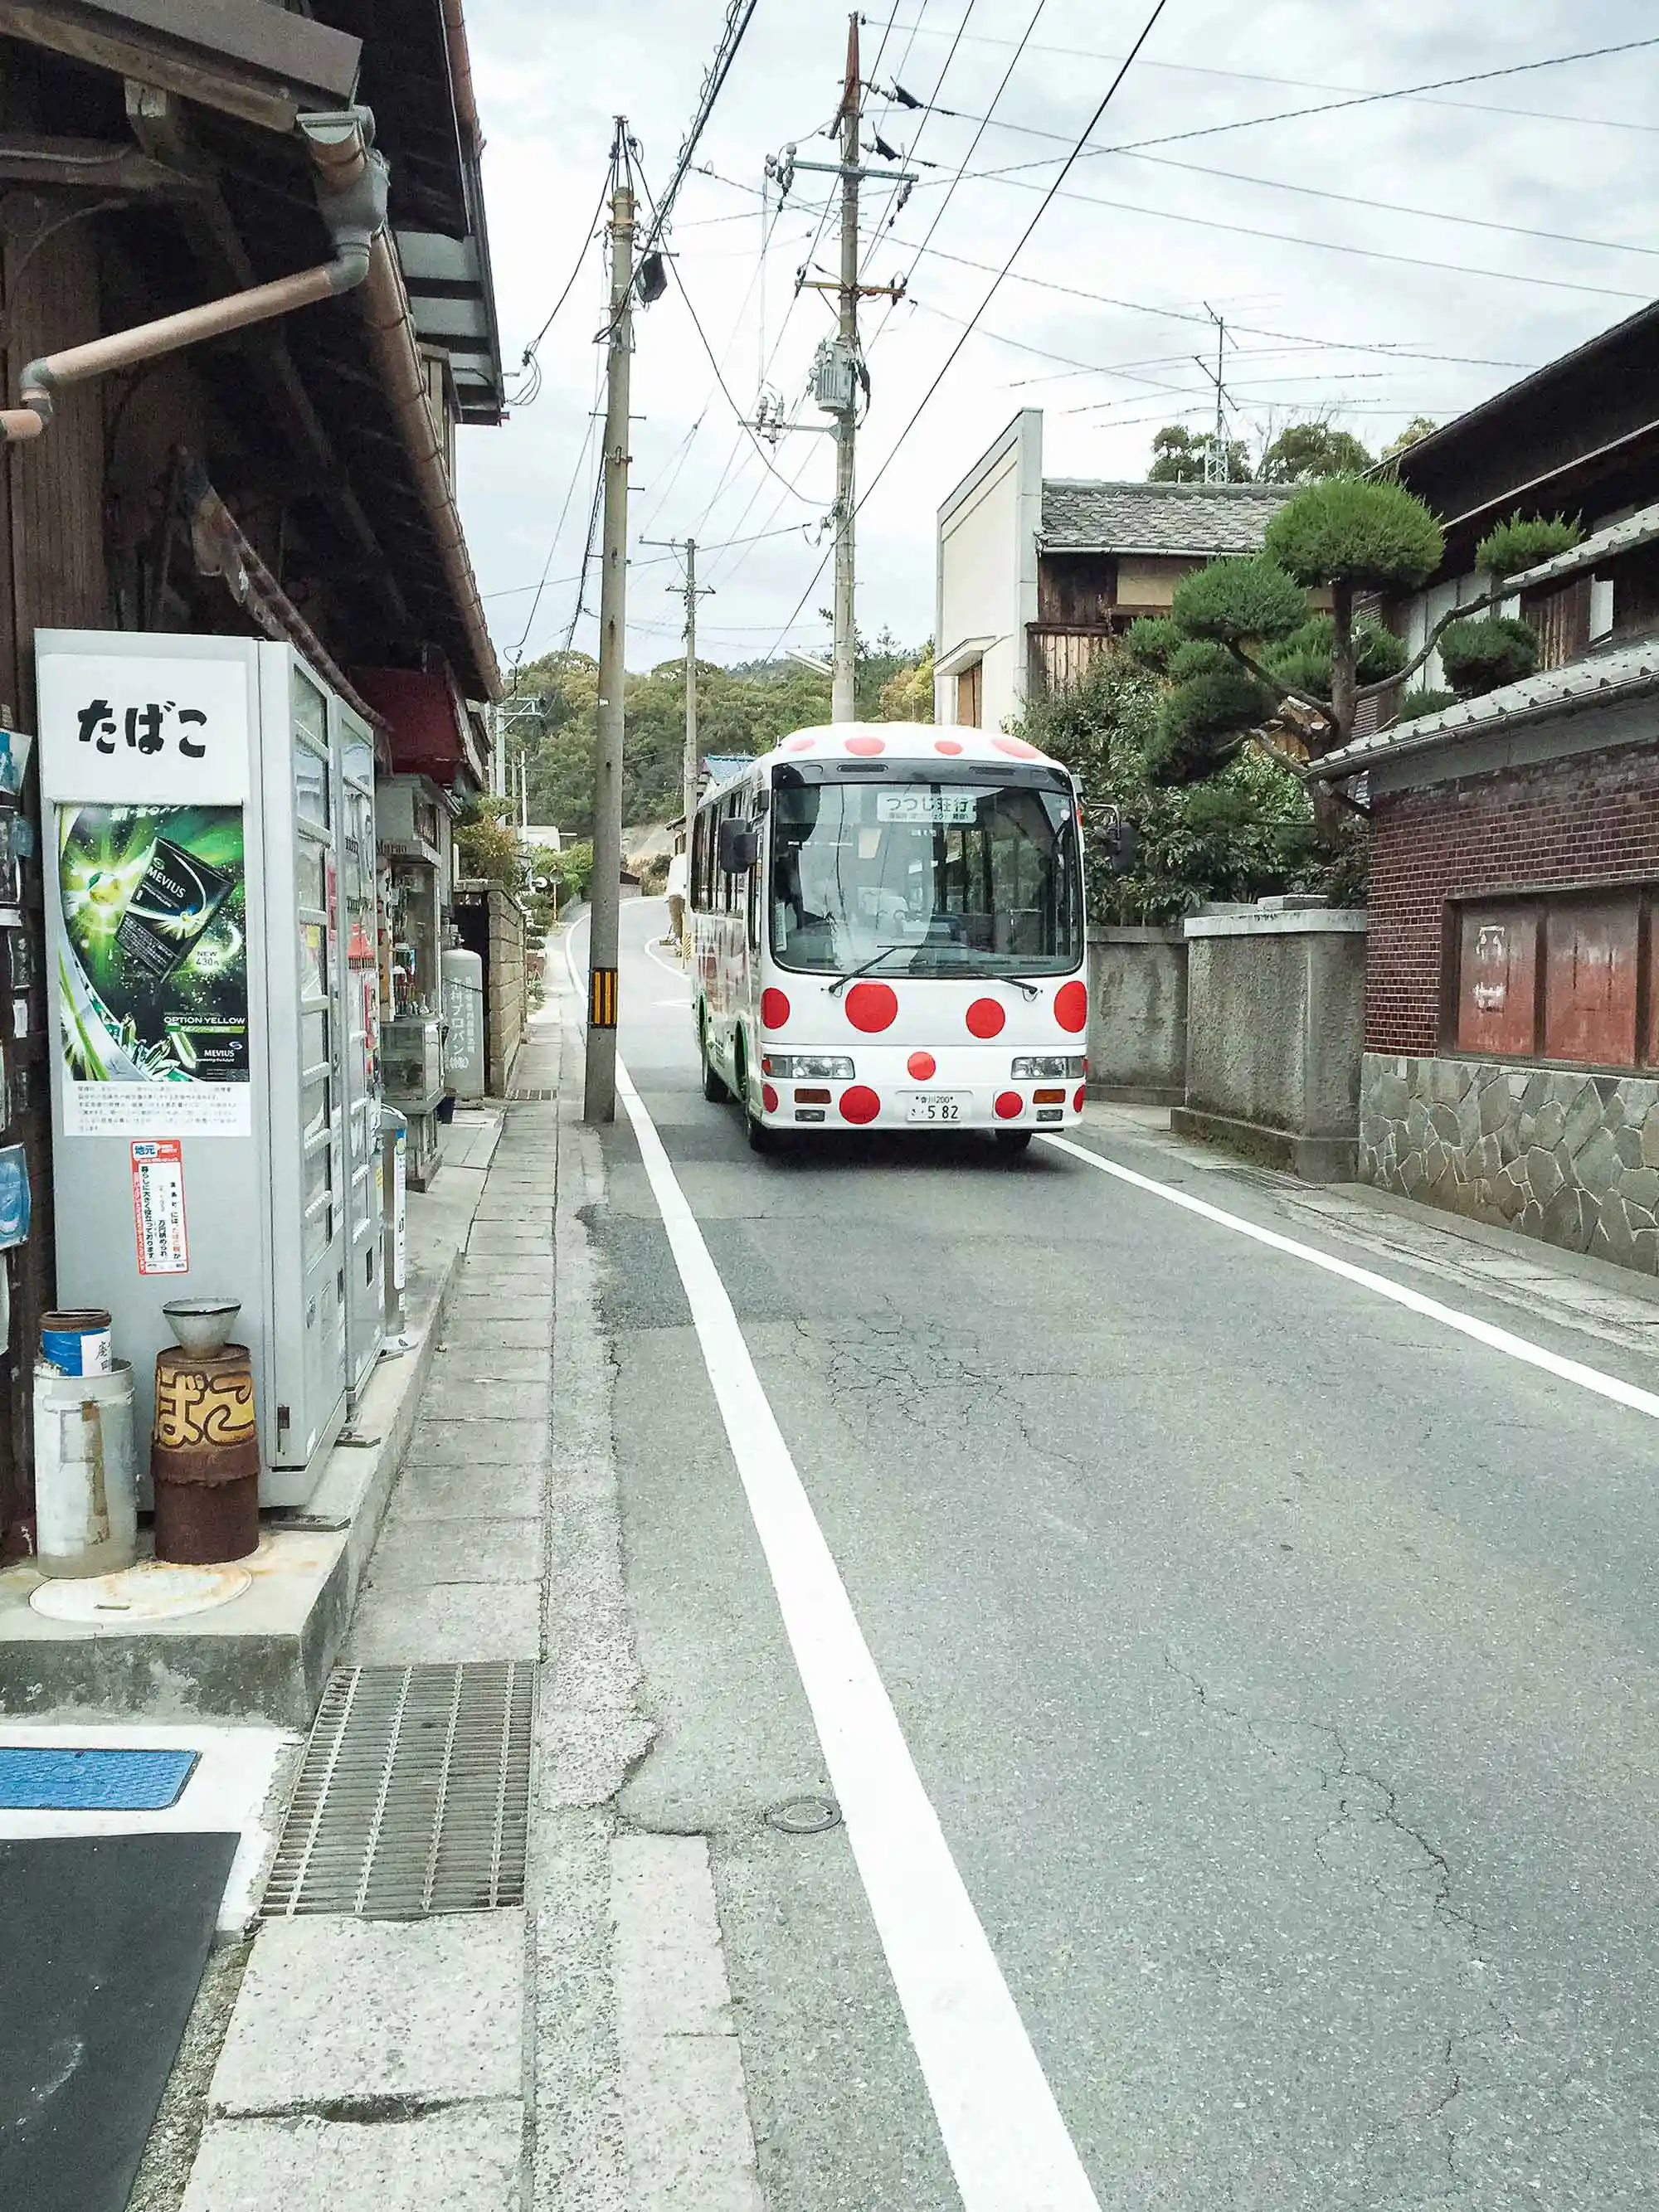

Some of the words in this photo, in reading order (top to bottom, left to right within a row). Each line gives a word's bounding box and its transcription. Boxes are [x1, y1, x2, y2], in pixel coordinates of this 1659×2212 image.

[77, 699, 207, 758] たばこ
[148, 868, 187, 898] MEVIUS
[134, 1145, 156, 1155] 地元
